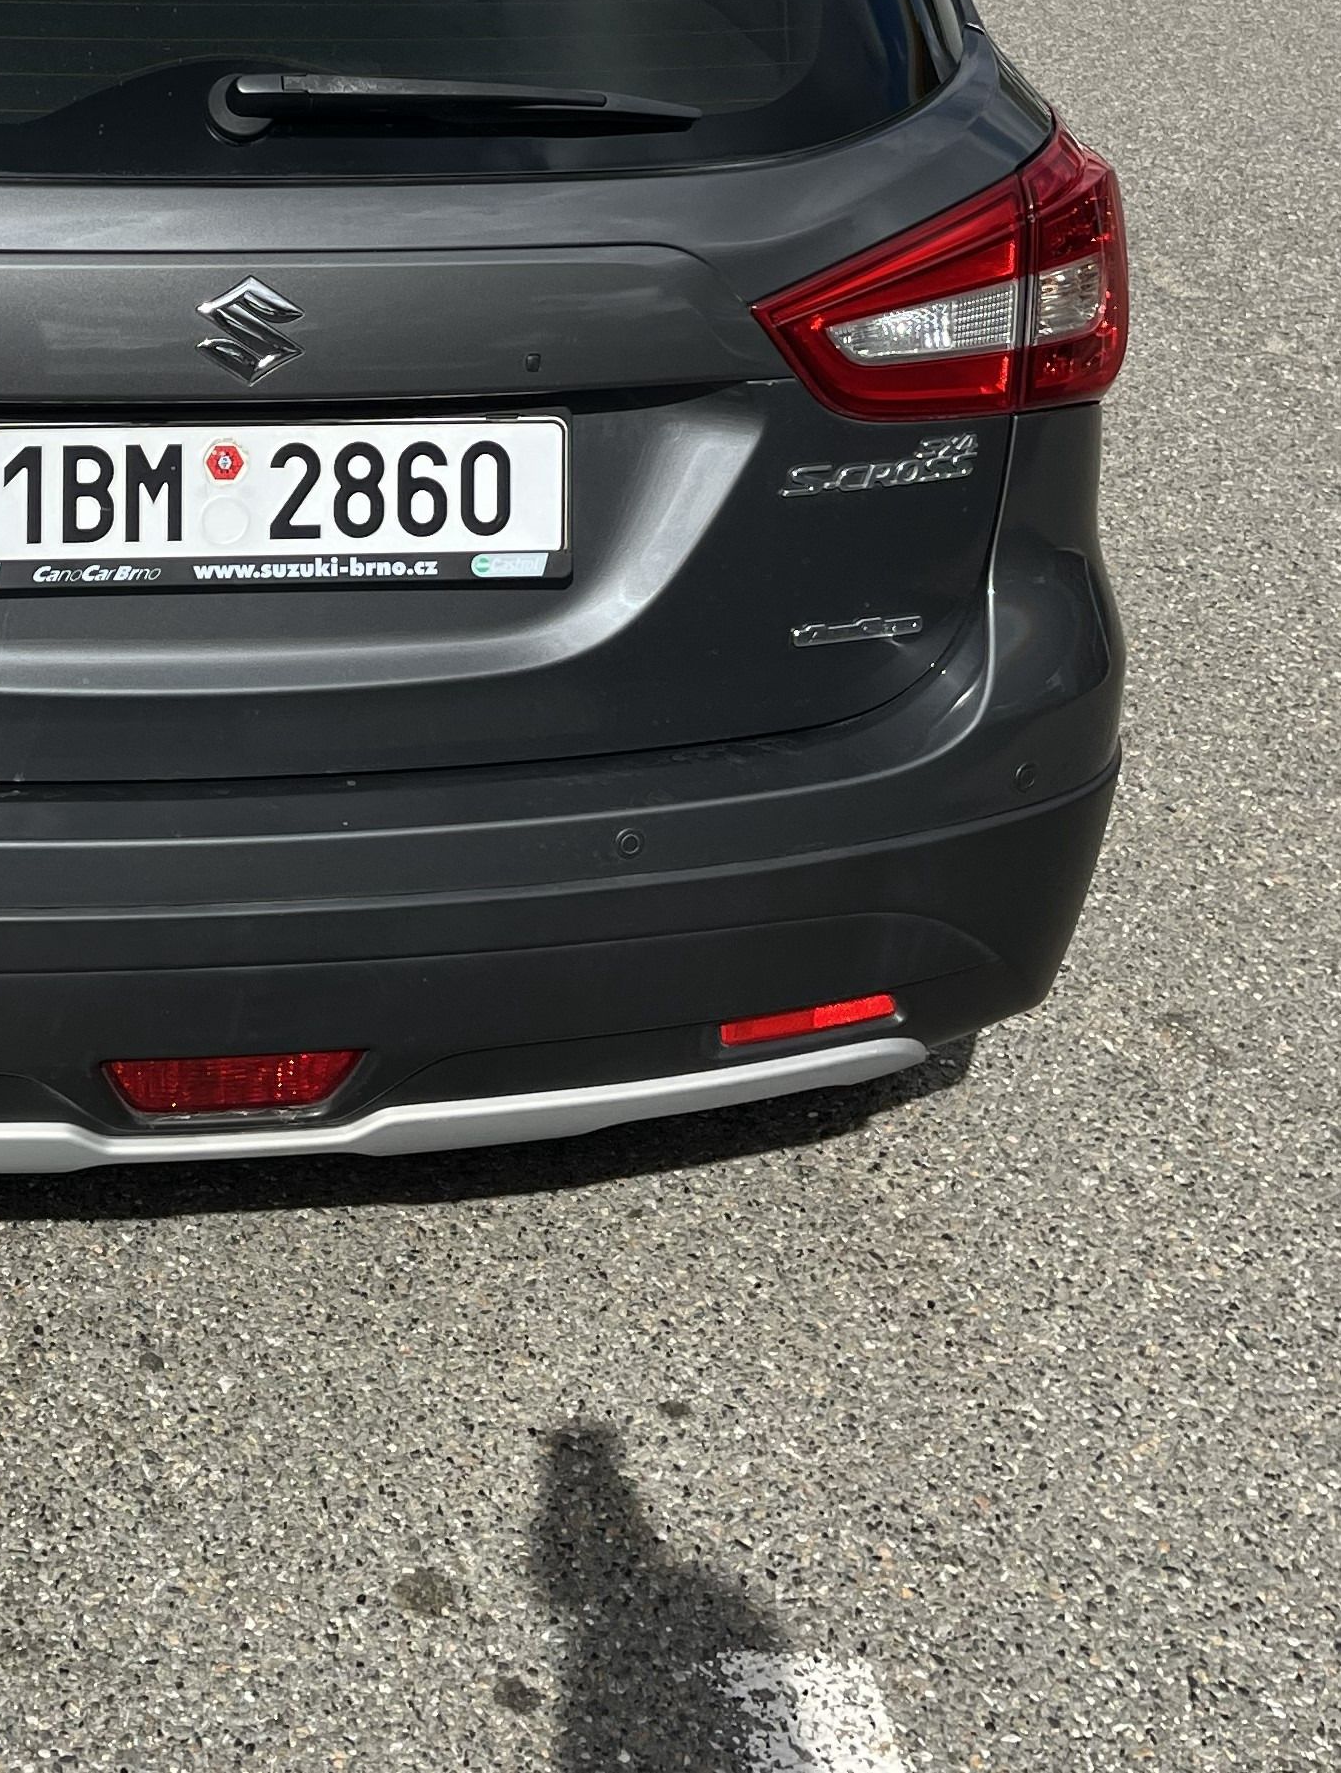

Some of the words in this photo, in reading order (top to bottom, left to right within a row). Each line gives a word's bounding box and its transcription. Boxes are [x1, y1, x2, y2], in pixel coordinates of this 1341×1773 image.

[4, 444, 183, 544] 1BM
[270, 440, 511, 540] 2860
[193, 557, 438, 580] www.suzuki-brno.cz
